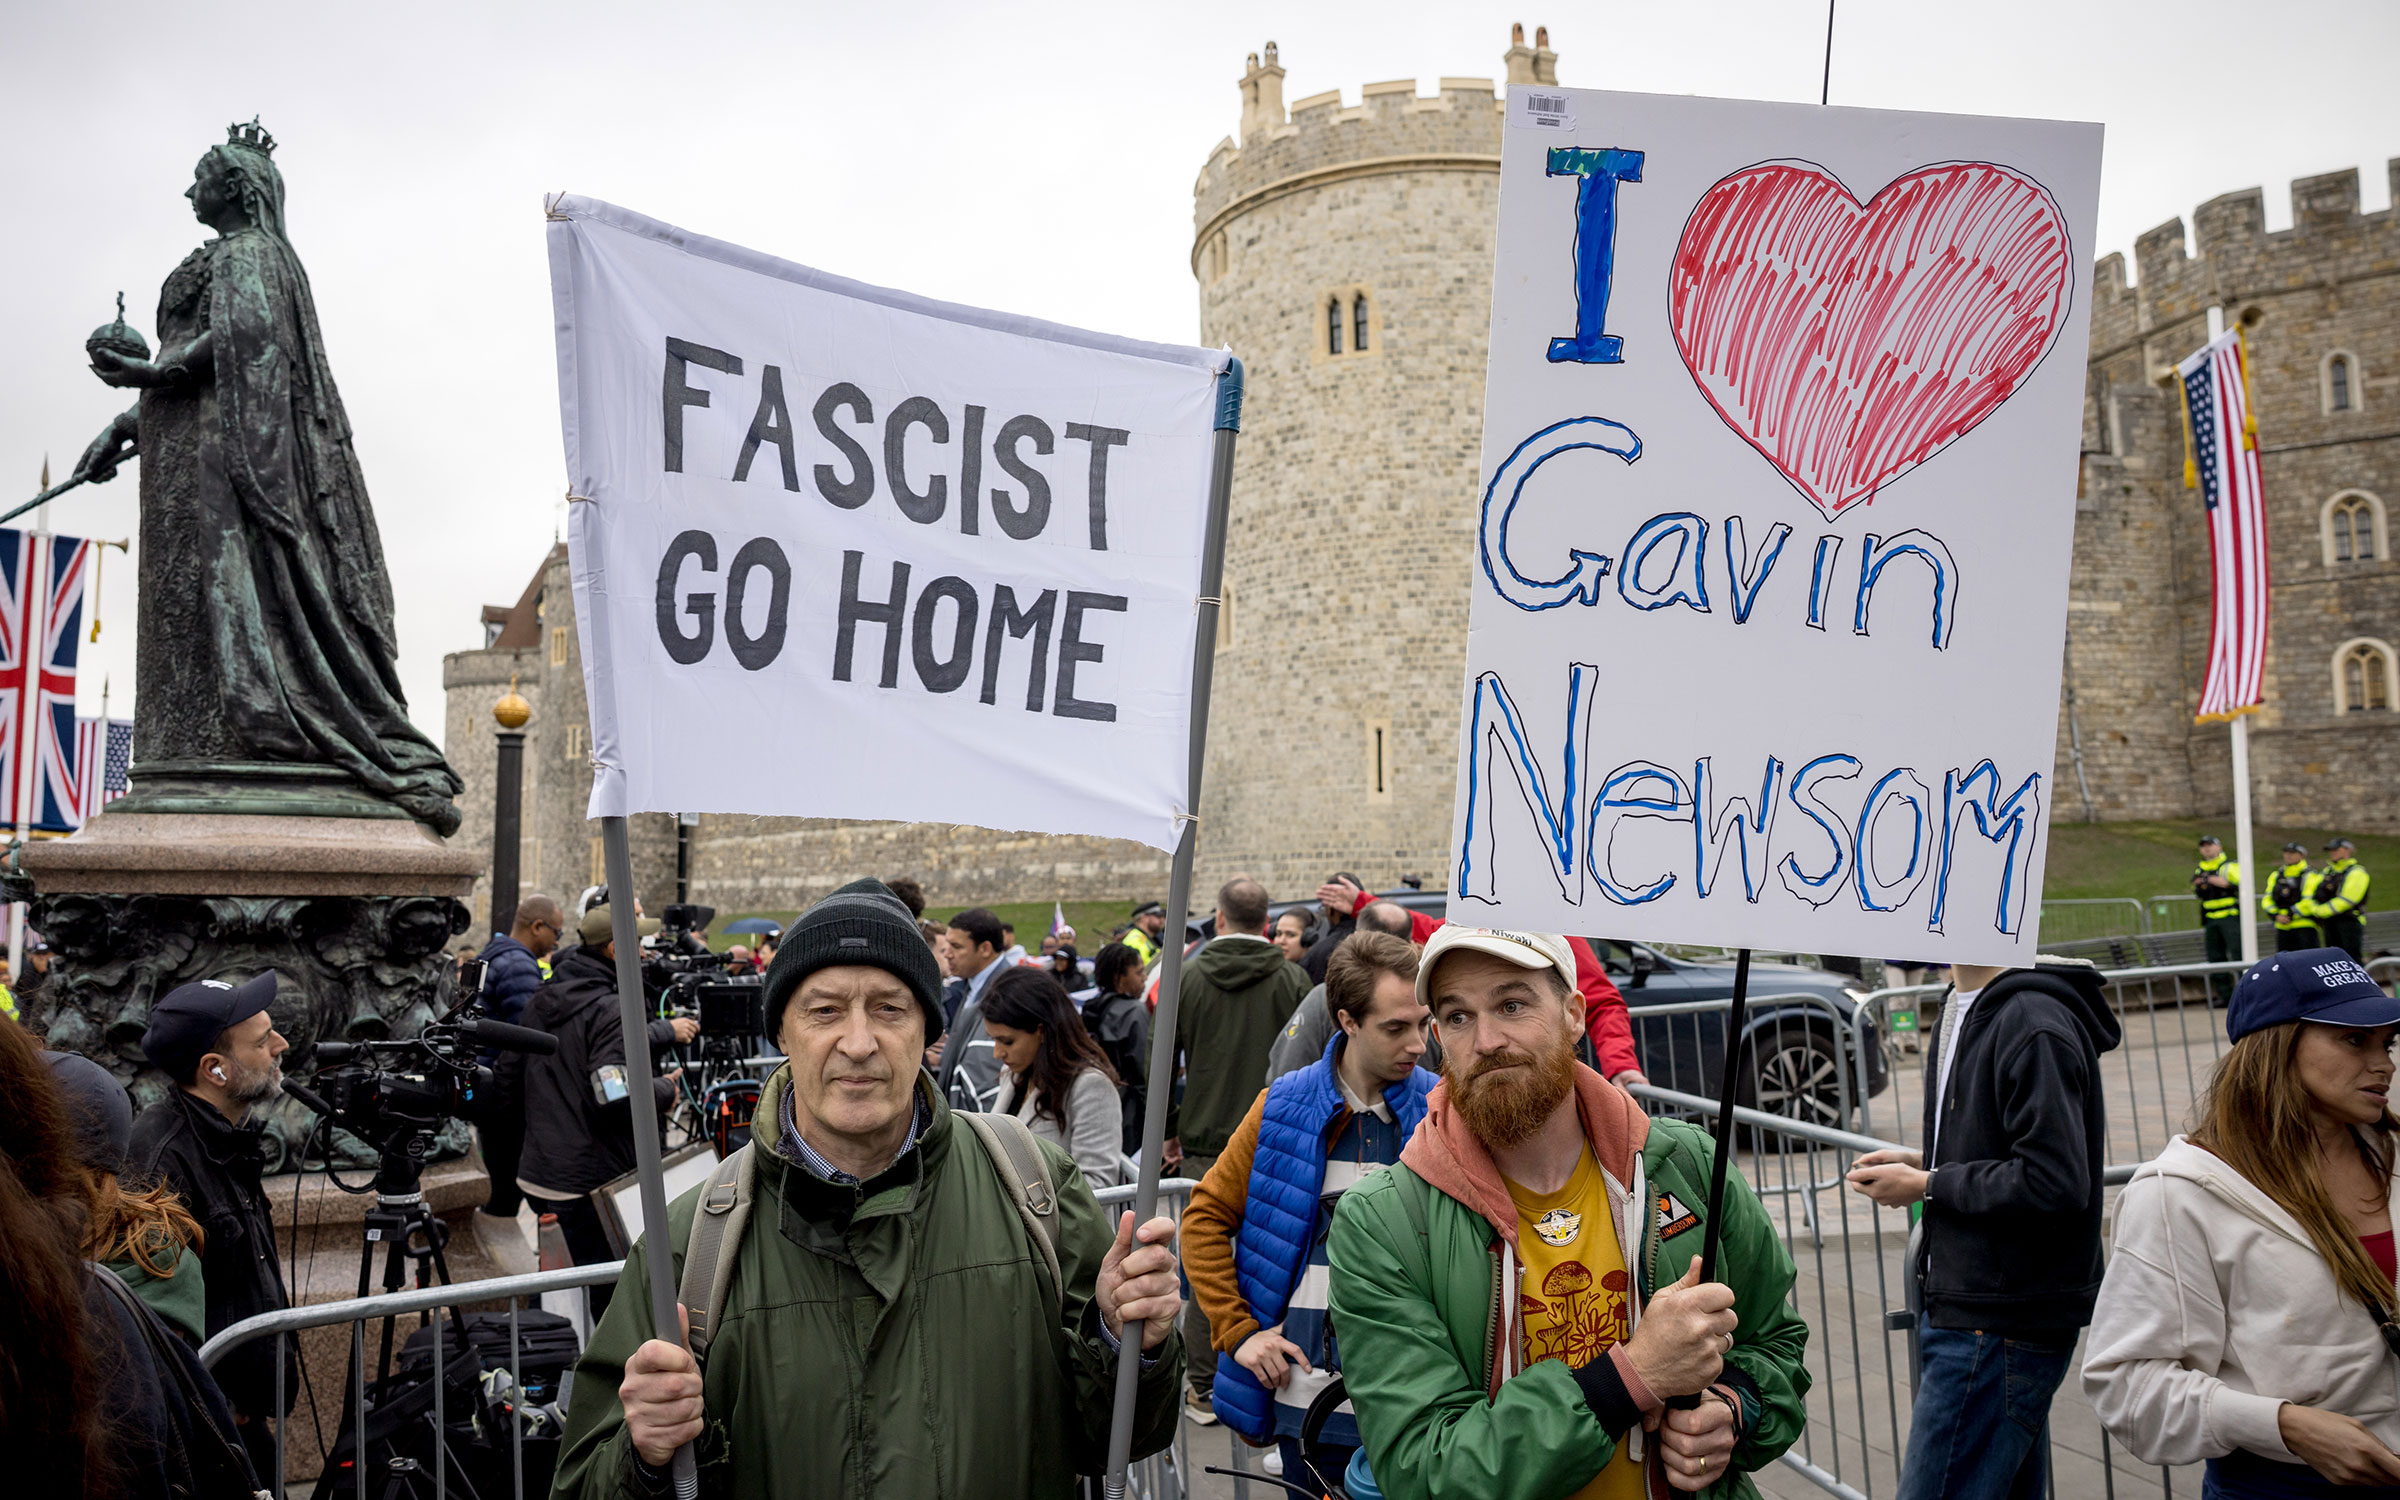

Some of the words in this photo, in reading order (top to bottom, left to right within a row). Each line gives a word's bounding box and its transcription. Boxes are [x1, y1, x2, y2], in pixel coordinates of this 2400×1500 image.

[1545, 145, 1646, 364] I
[662, 336, 1130, 552] FASCIST
[1478, 416, 1960, 652] Gavin
[655, 529, 791, 671] GO
[832, 549, 1128, 723] HOME
[1458, 661, 2041, 944] Newsom
[2311, 960, 2353, 978] MAKE
[2323, 972, 2369, 988] GREAT
